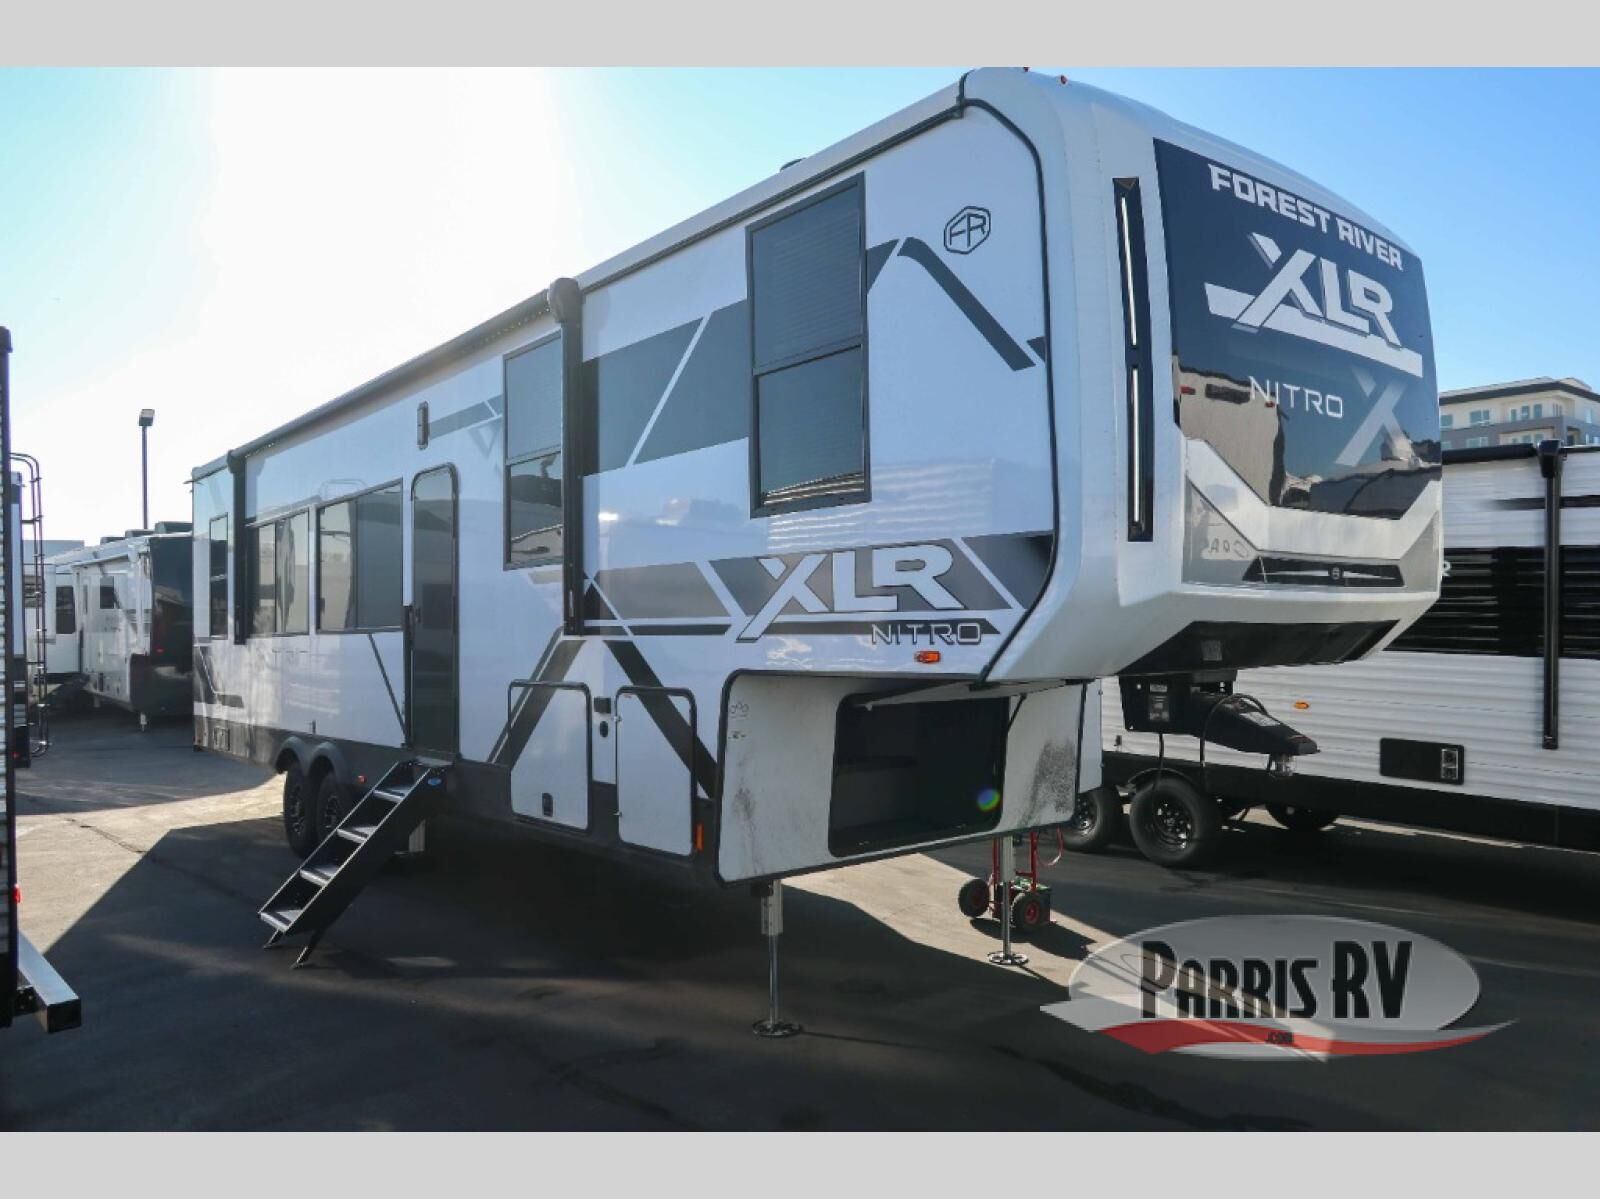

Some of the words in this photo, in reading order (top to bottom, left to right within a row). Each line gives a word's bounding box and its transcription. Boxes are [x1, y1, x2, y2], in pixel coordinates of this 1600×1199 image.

[1207, 163, 1331, 233] FOREST
[1336, 217, 1403, 271] RIVER
[1232, 232, 1401, 350] XLR
[1249, 376, 1343, 418] NITRO
[736, 544, 967, 643] XLR
[871, 622, 982, 645] NITRO
